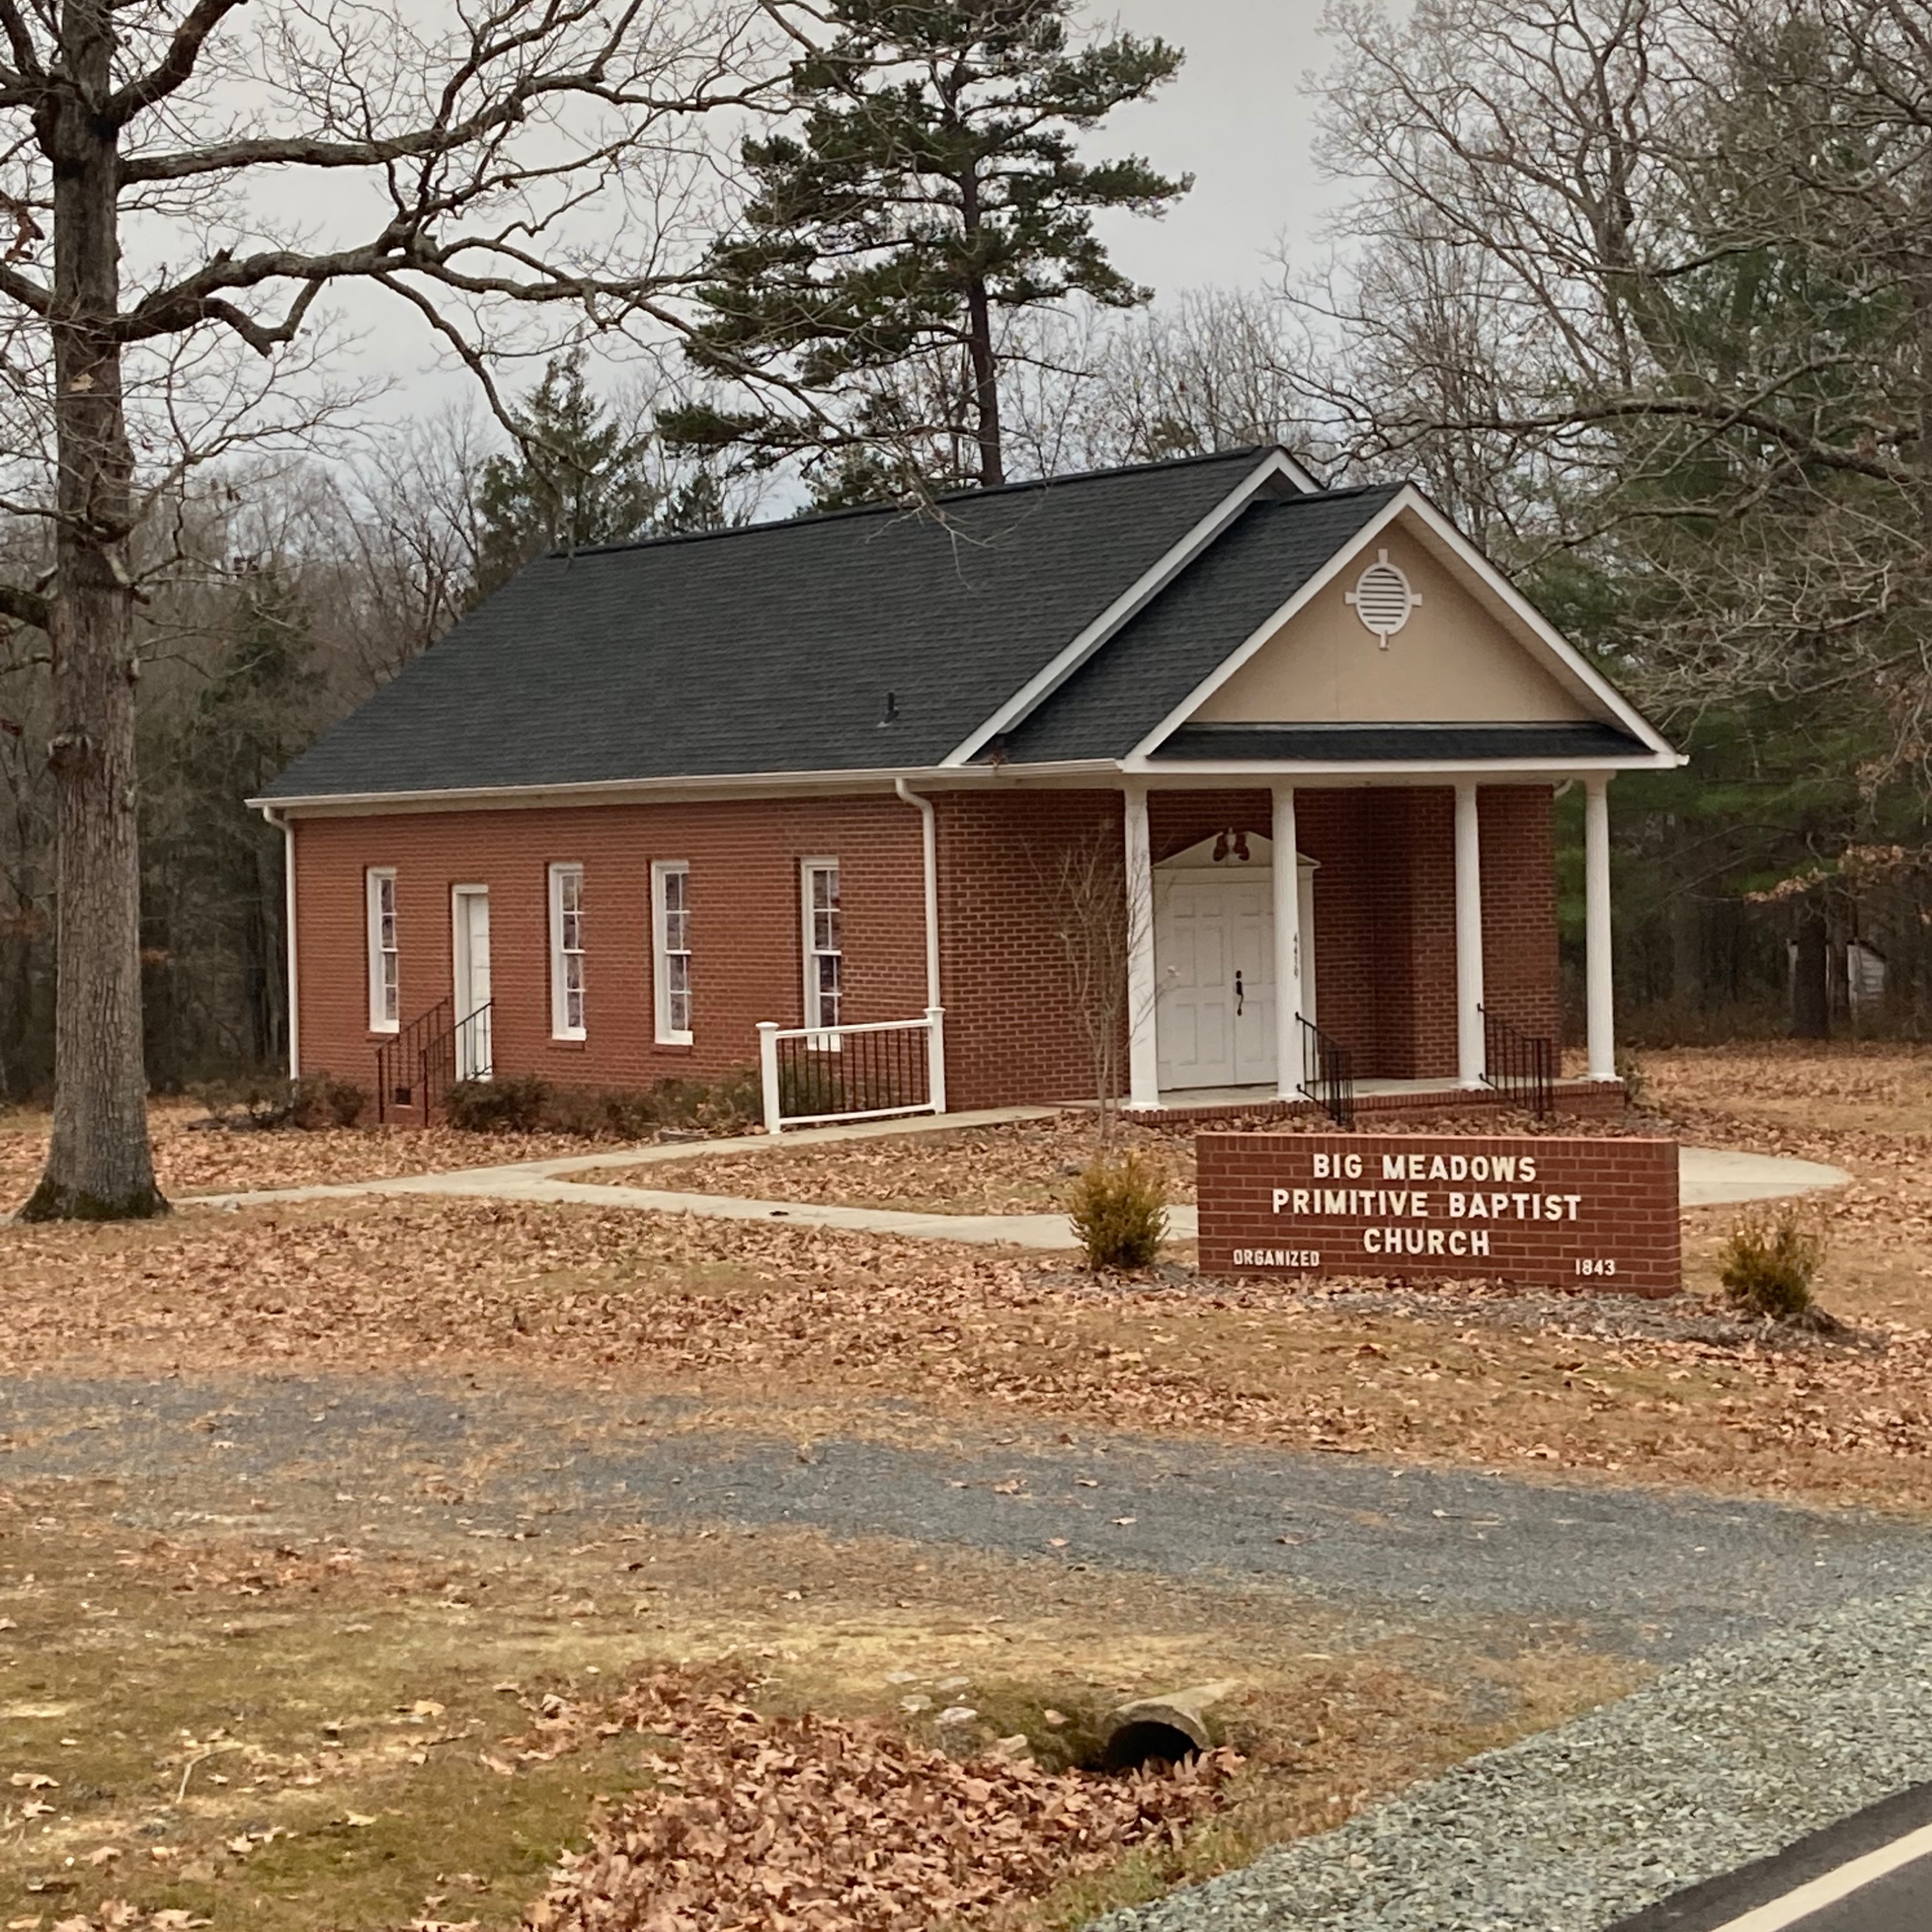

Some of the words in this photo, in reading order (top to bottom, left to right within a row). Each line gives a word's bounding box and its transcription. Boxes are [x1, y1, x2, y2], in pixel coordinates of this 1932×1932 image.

[1313, 1153, 1363, 1179] BIG
[1383, 1155, 1536, 1182] MEADOWS
[1273, 1188, 1428, 1217] PRIMITIVE
[1449, 1192, 1582, 1221] BAPTIST
[1363, 1227, 1490, 1256] CHURCH
[1233, 1249, 1320, 1267] ORGANIZED
[1575, 1258, 1615, 1276] 1843
